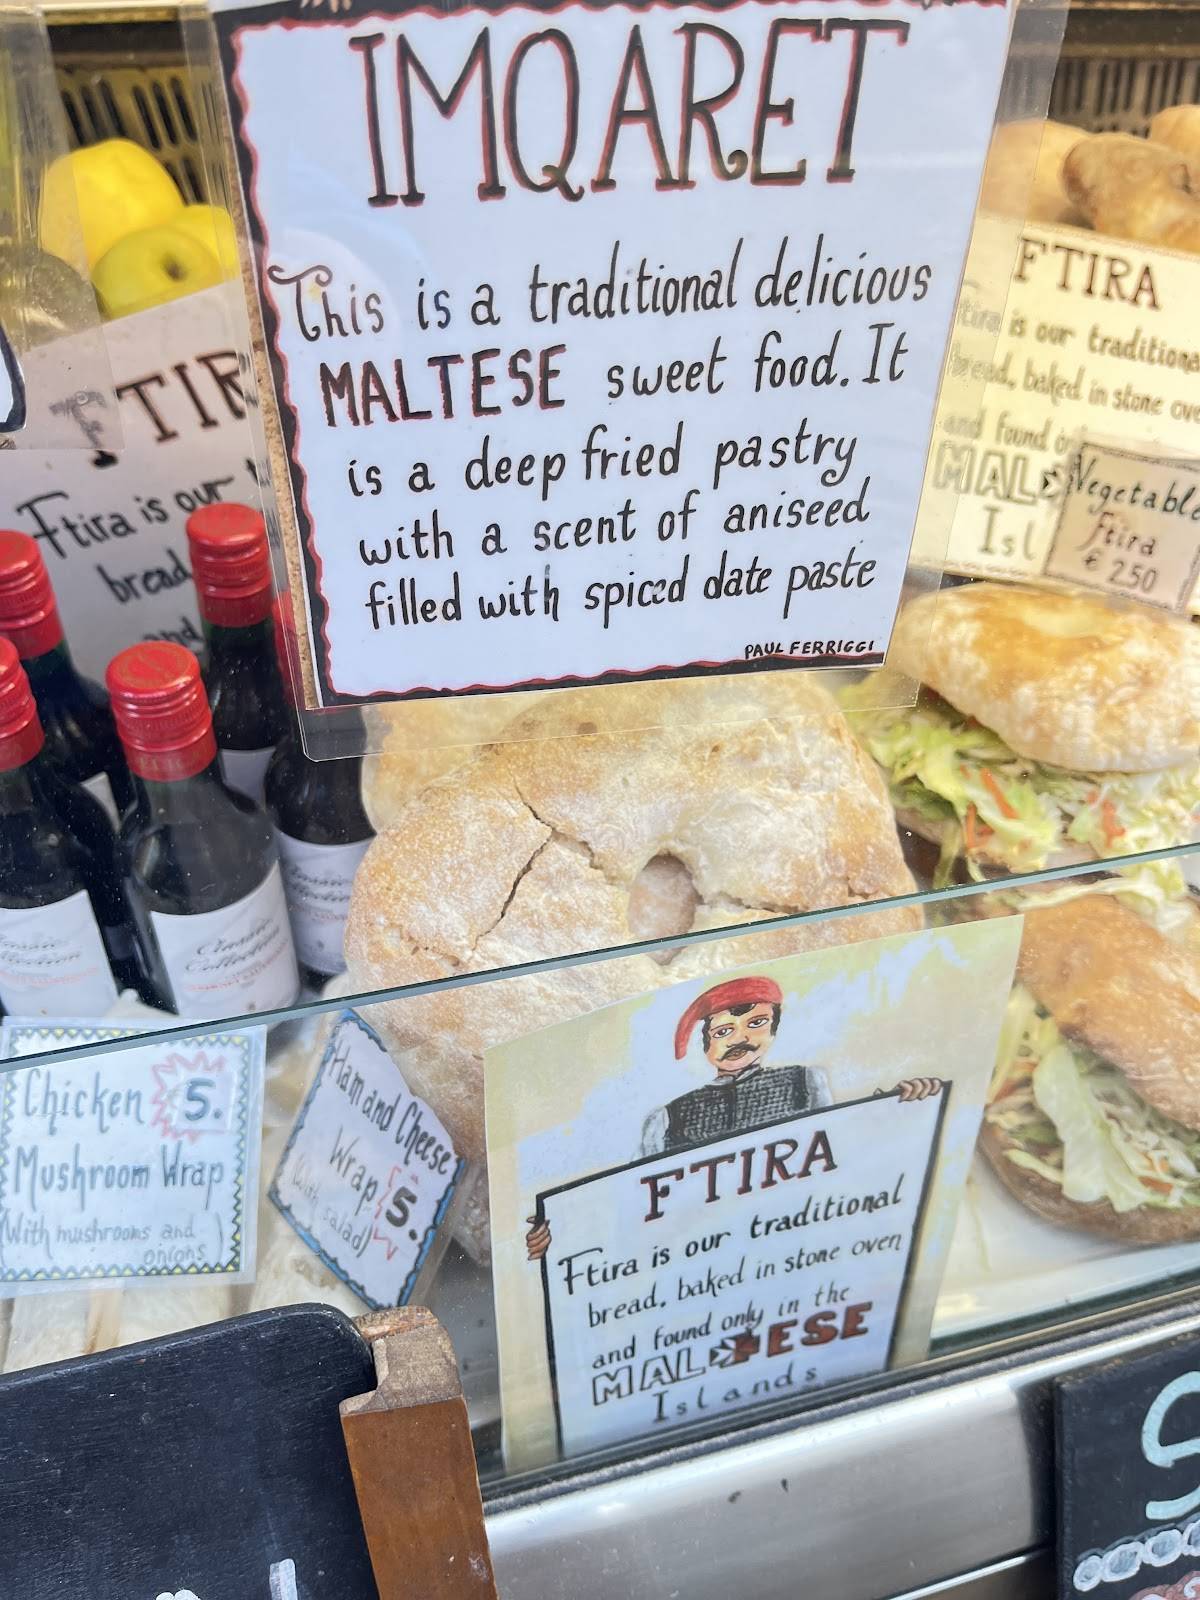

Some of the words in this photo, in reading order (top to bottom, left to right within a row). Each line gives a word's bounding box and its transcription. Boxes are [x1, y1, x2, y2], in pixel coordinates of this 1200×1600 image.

[349, 18, 910, 206] IMQARET
[267, 264, 385, 342] This
[417, 281, 451, 331] is
[470, 286, 500, 325] a
[528, 238, 743, 322] traditional
[755, 233, 932, 313] delicious
[1013, 237, 1163, 311] FTIRA
[1008, 308, 1028, 339] is
[1034, 320, 1076, 347] our
[319, 344, 567, 427] MALTESE
[607, 335, 725, 399] sweet
[753, 330, 849, 393] food.
[861, 323, 908, 383] It
[1023, 360, 1086, 407] baked
[1088, 378, 1109, 407] in
[1112, 384, 1163, 416] stone
[348, 458, 382, 497] is
[408, 465, 435, 493] a
[466, 435, 567, 500] deep
[582, 421, 684, 479] fried
[713, 417, 858, 490] pastry
[994, 409, 1053, 451] found
[16, 489, 138, 560] Ftira
[140, 494, 169, 525] is
[177, 477, 235, 514] our
[359, 509, 454, 567] with
[481, 521, 507, 556] a
[533, 498, 636, 553] scent
[657, 488, 700, 541] of
[723, 476, 870, 534] aniseed
[1076, 510, 1157, 556] Ftira
[365, 579, 461, 630] filled
[478, 564, 559, 622] with
[584, 554, 689, 629] spiced
[702, 557, 771, 601] date
[783, 539, 876, 619] paste
[143, 616, 204, 650] nd
[744, 641, 785, 660] PAUL
[789, 639, 875, 655] FERRIGGI
[24, 1067, 145, 1135] Chicken
[329, 1040, 365, 1107] Ham
[362, 1090, 402, 1132] and
[395, 1100, 453, 1176] Cheese
[13, 1142, 150, 1212] Mushroom
[161, 1140, 225, 1210] Wrap
[329, 1124, 379, 1216] Wrap
[640, 1130, 838, 1222] FTIRA
[56, 1217, 151, 1245] mushrooms
[161, 1212, 197, 1239] and
[558, 1247, 639, 1295] Ftira
[651, 1245, 671, 1268] is
[685, 1231, 731, 1258] our
[750, 1172, 905, 1239] traditional
[678, 1255, 745, 1301] baked
[755, 1259, 776, 1280] in
[784, 1245, 840, 1273] stone
[852, 1232, 902, 1256] oven
[592, 1334, 636, 1369] and
[653, 1311, 713, 1350] found
[720, 1299, 764, 1332] only
[777, 1295, 801, 1317] in
[814, 1279, 850, 1307] the
[652, 1360, 818, 1424] Islands
